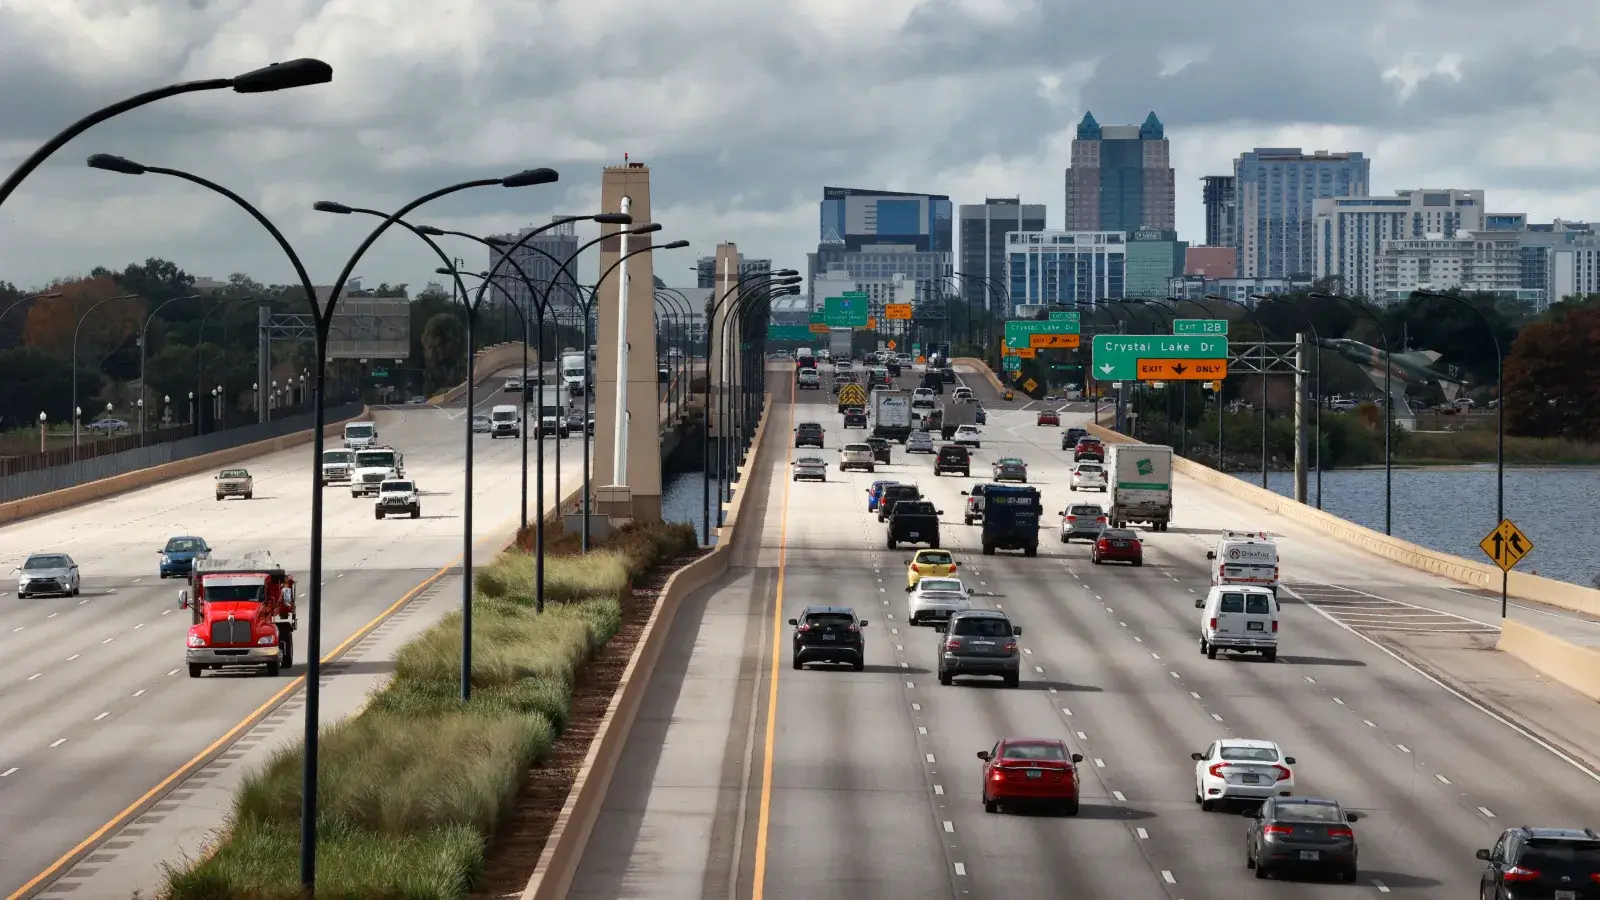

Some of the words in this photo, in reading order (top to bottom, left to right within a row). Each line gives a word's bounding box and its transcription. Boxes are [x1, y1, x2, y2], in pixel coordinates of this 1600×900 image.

[1203, 323, 1221, 332] 12B
[1105, 342, 1150, 352] Crystal
[1161, 342, 1190, 351] Lake
[1201, 342, 1214, 351] Dr
